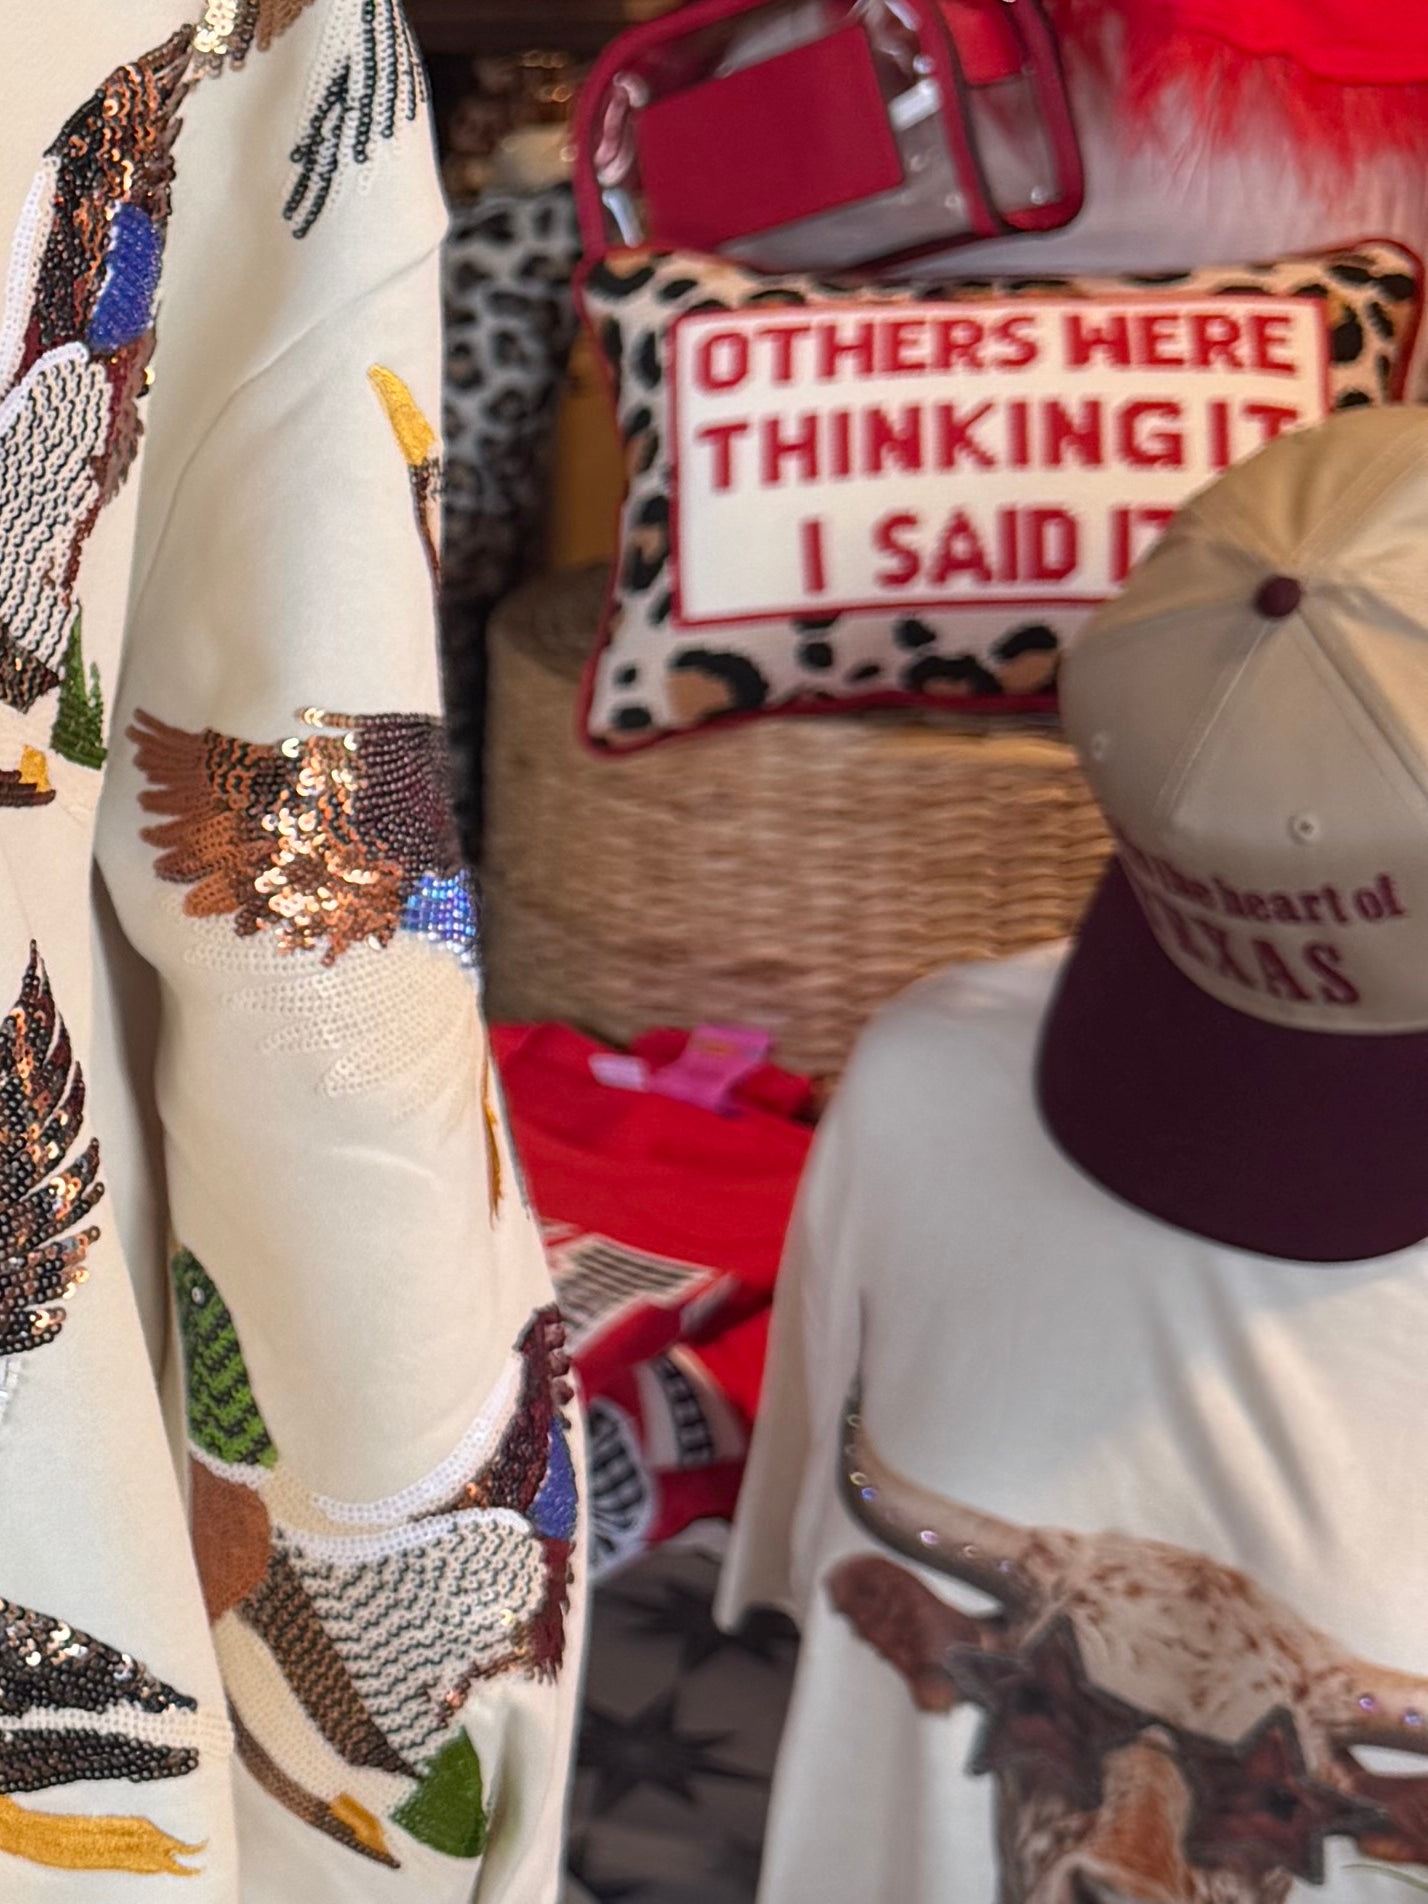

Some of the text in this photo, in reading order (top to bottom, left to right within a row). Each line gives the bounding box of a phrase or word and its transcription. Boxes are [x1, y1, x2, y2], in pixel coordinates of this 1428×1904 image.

[695, 313, 1299, 392] OTHERS WERE
[696, 399, 1188, 493] THINKING
[800, 517, 828, 596] I
[871, 501, 1081, 587] SAID
[1353, 871, 1406, 923] of
